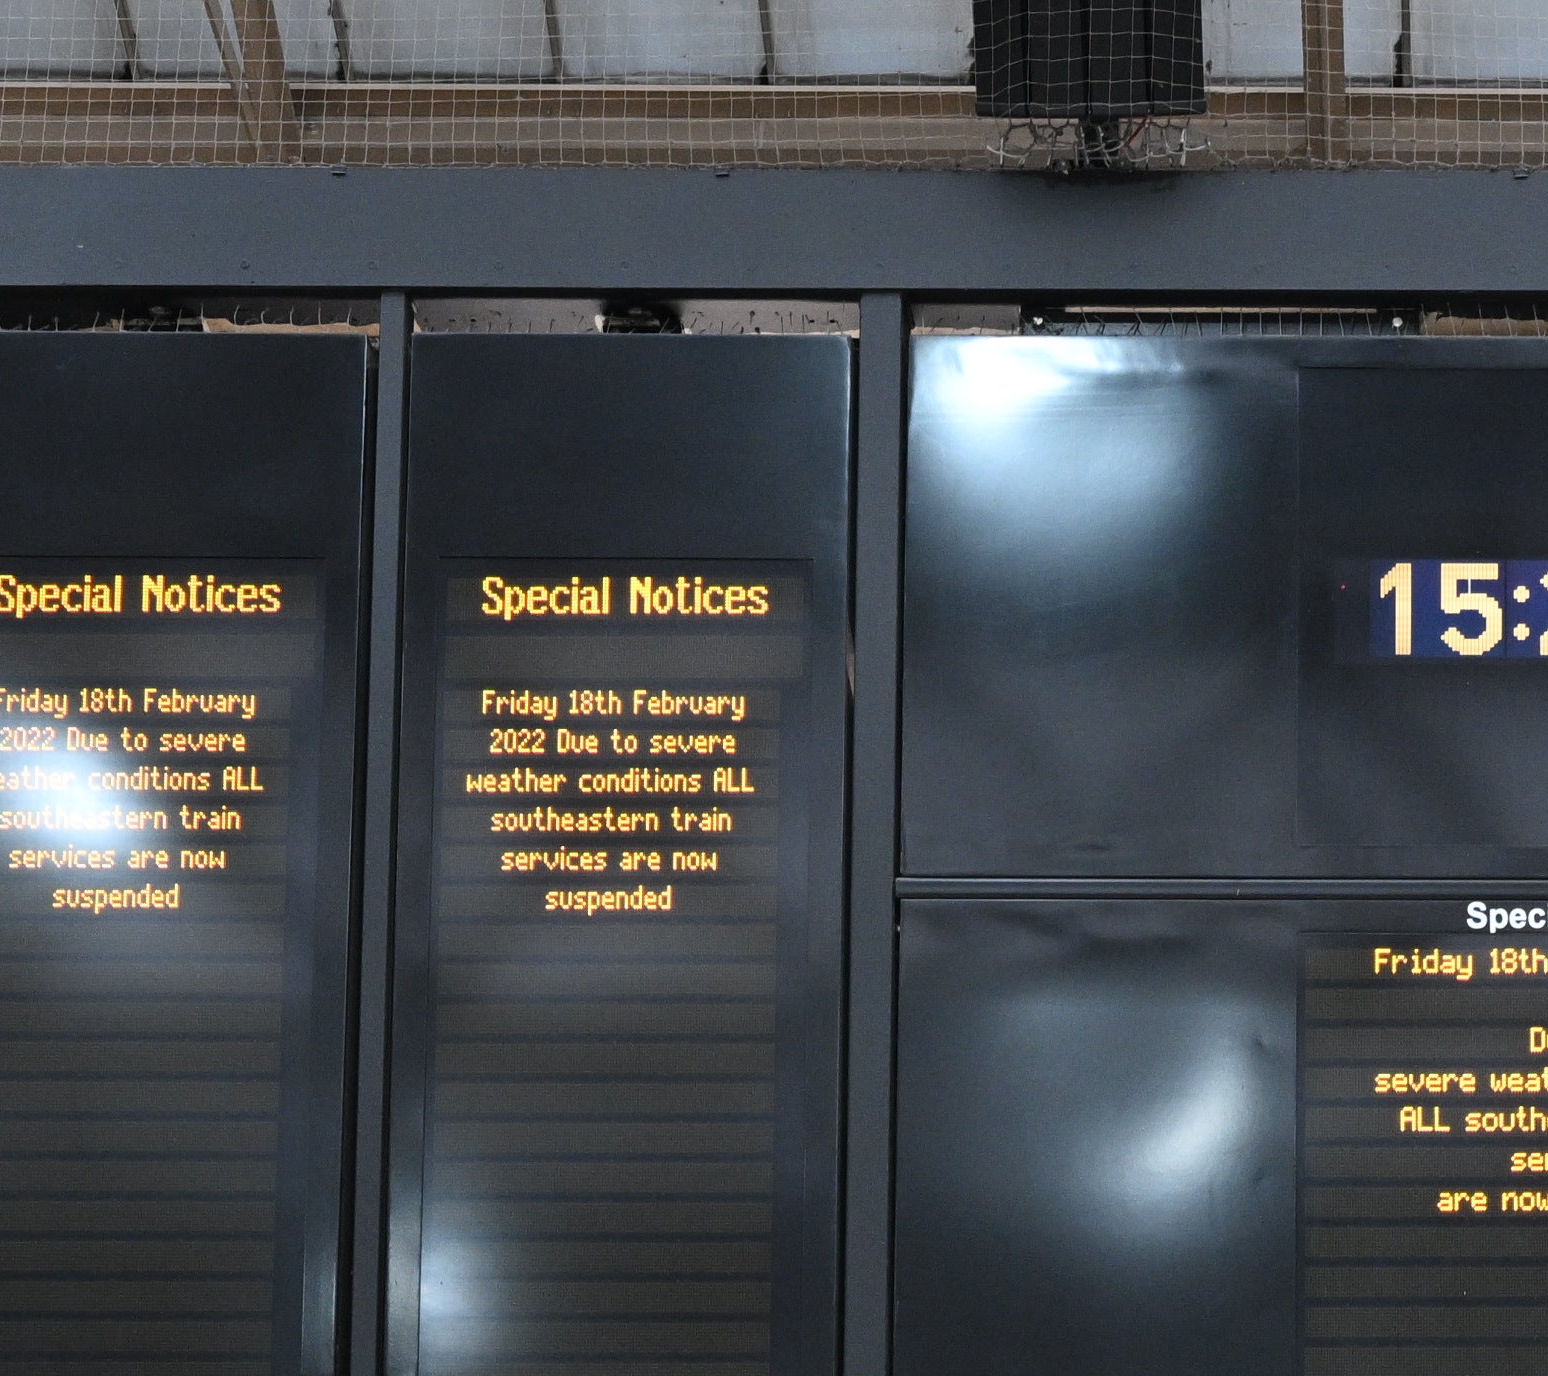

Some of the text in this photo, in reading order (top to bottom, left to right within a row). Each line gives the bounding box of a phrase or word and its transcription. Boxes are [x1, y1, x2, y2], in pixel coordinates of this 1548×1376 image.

[141, 574, 283, 614] Notices
[481, 576, 770, 622] Special Notices
[1373, 947, 1475, 982] Friday
[1374, 1072, 1477, 1094] severe
[1399, 1105, 1451, 1133] ALL
[1436, 1191, 1489, 1213] are
